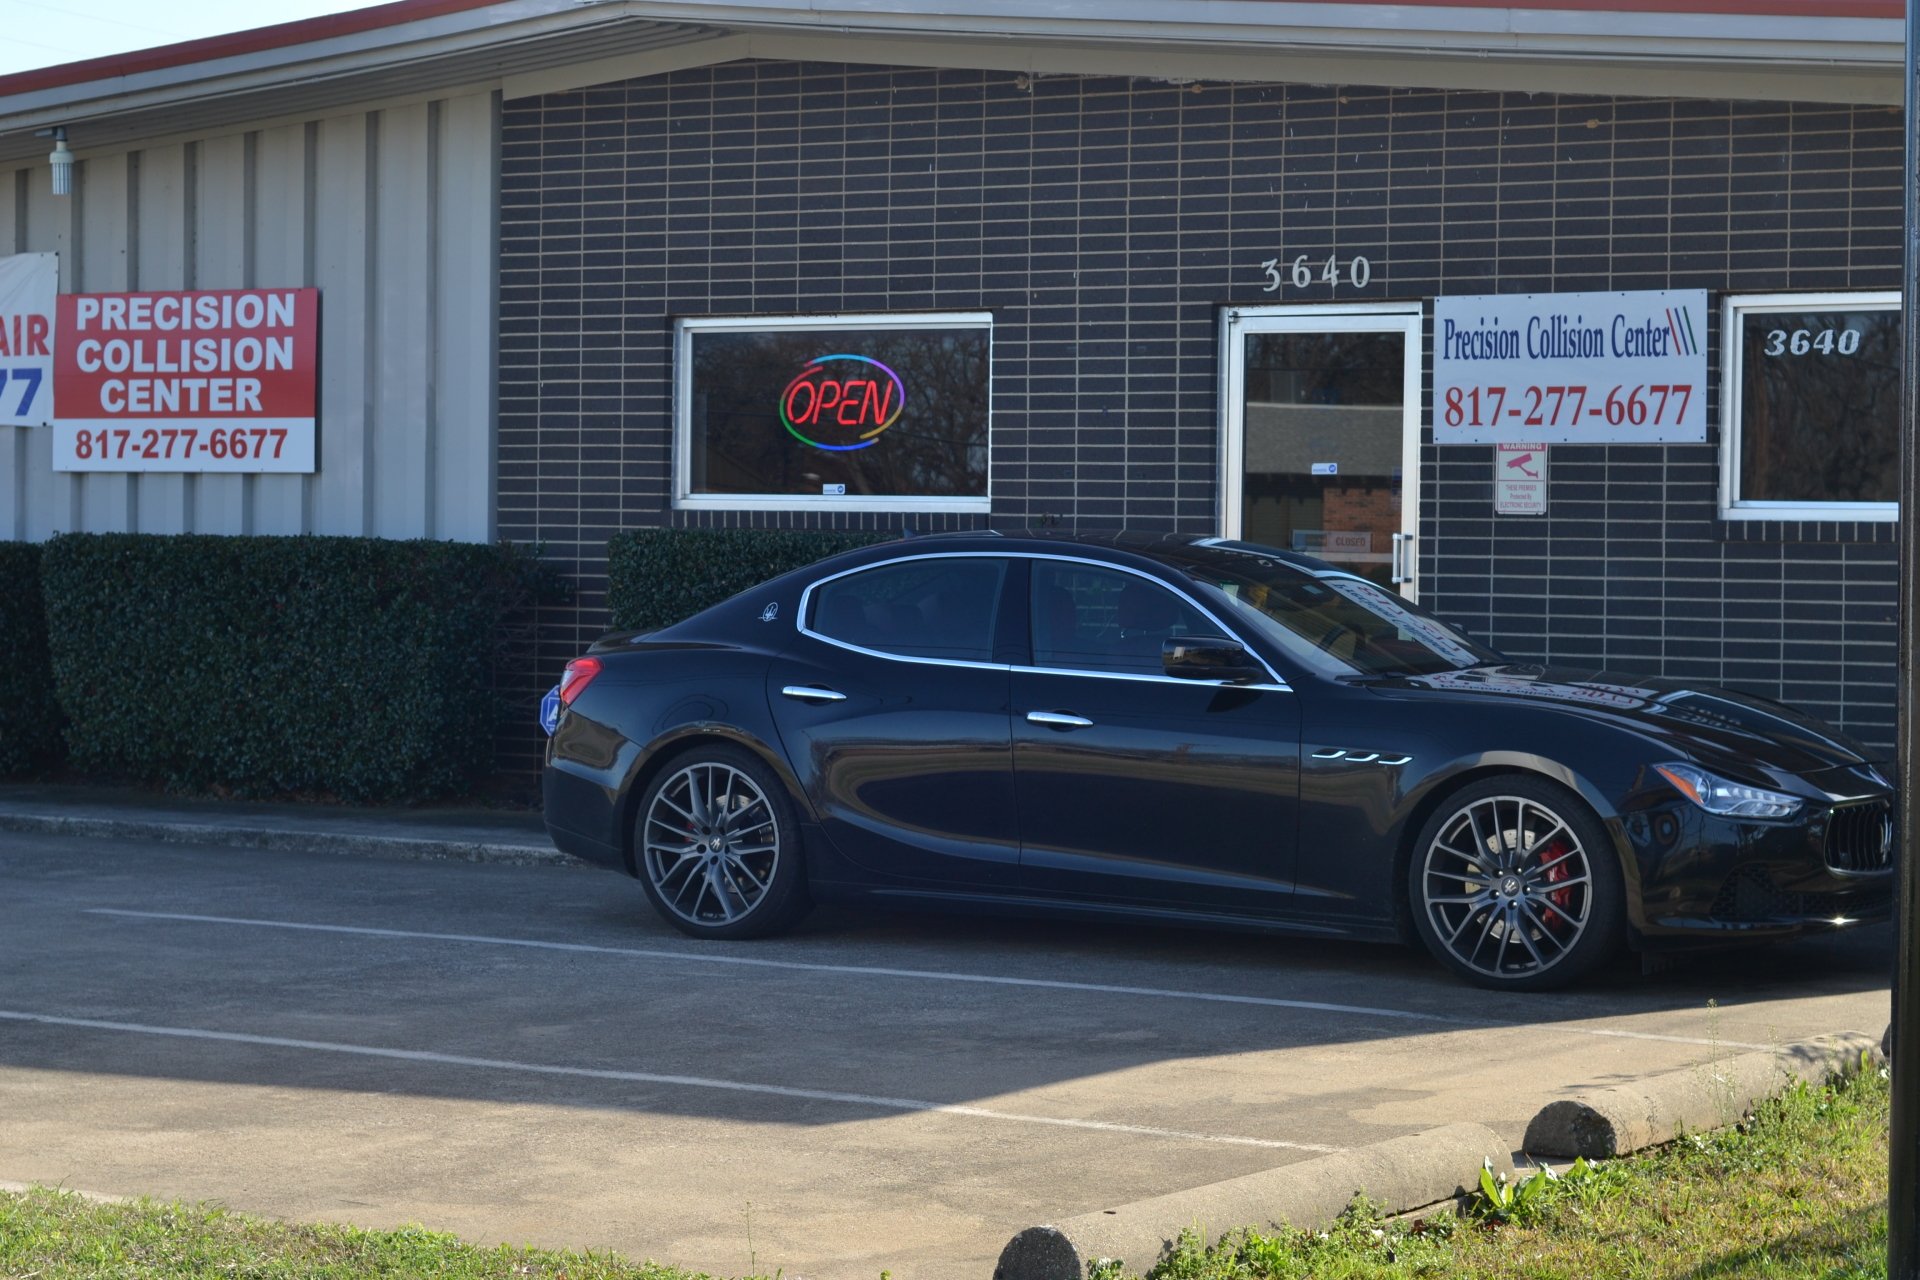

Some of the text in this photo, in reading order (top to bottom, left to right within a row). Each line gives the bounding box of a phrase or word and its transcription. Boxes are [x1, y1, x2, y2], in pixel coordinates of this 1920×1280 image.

[1261, 254, 1371, 292] 3640
[76, 293, 295, 331] PRECISION
[76, 336, 294, 373] COLLISION
[1443, 314, 1670, 361] Precision Collision Center
[1764, 329, 1860, 356] 3640
[0, 368, 42, 416] 7
[100, 377, 263, 413] CENTER
[786, 380, 893, 425] OPEN
[1444, 384, 1693, 426] 817-277-6677
[75, 428, 289, 459] 817-277-6677
[1335, 536, 1366, 547] CLOSED
